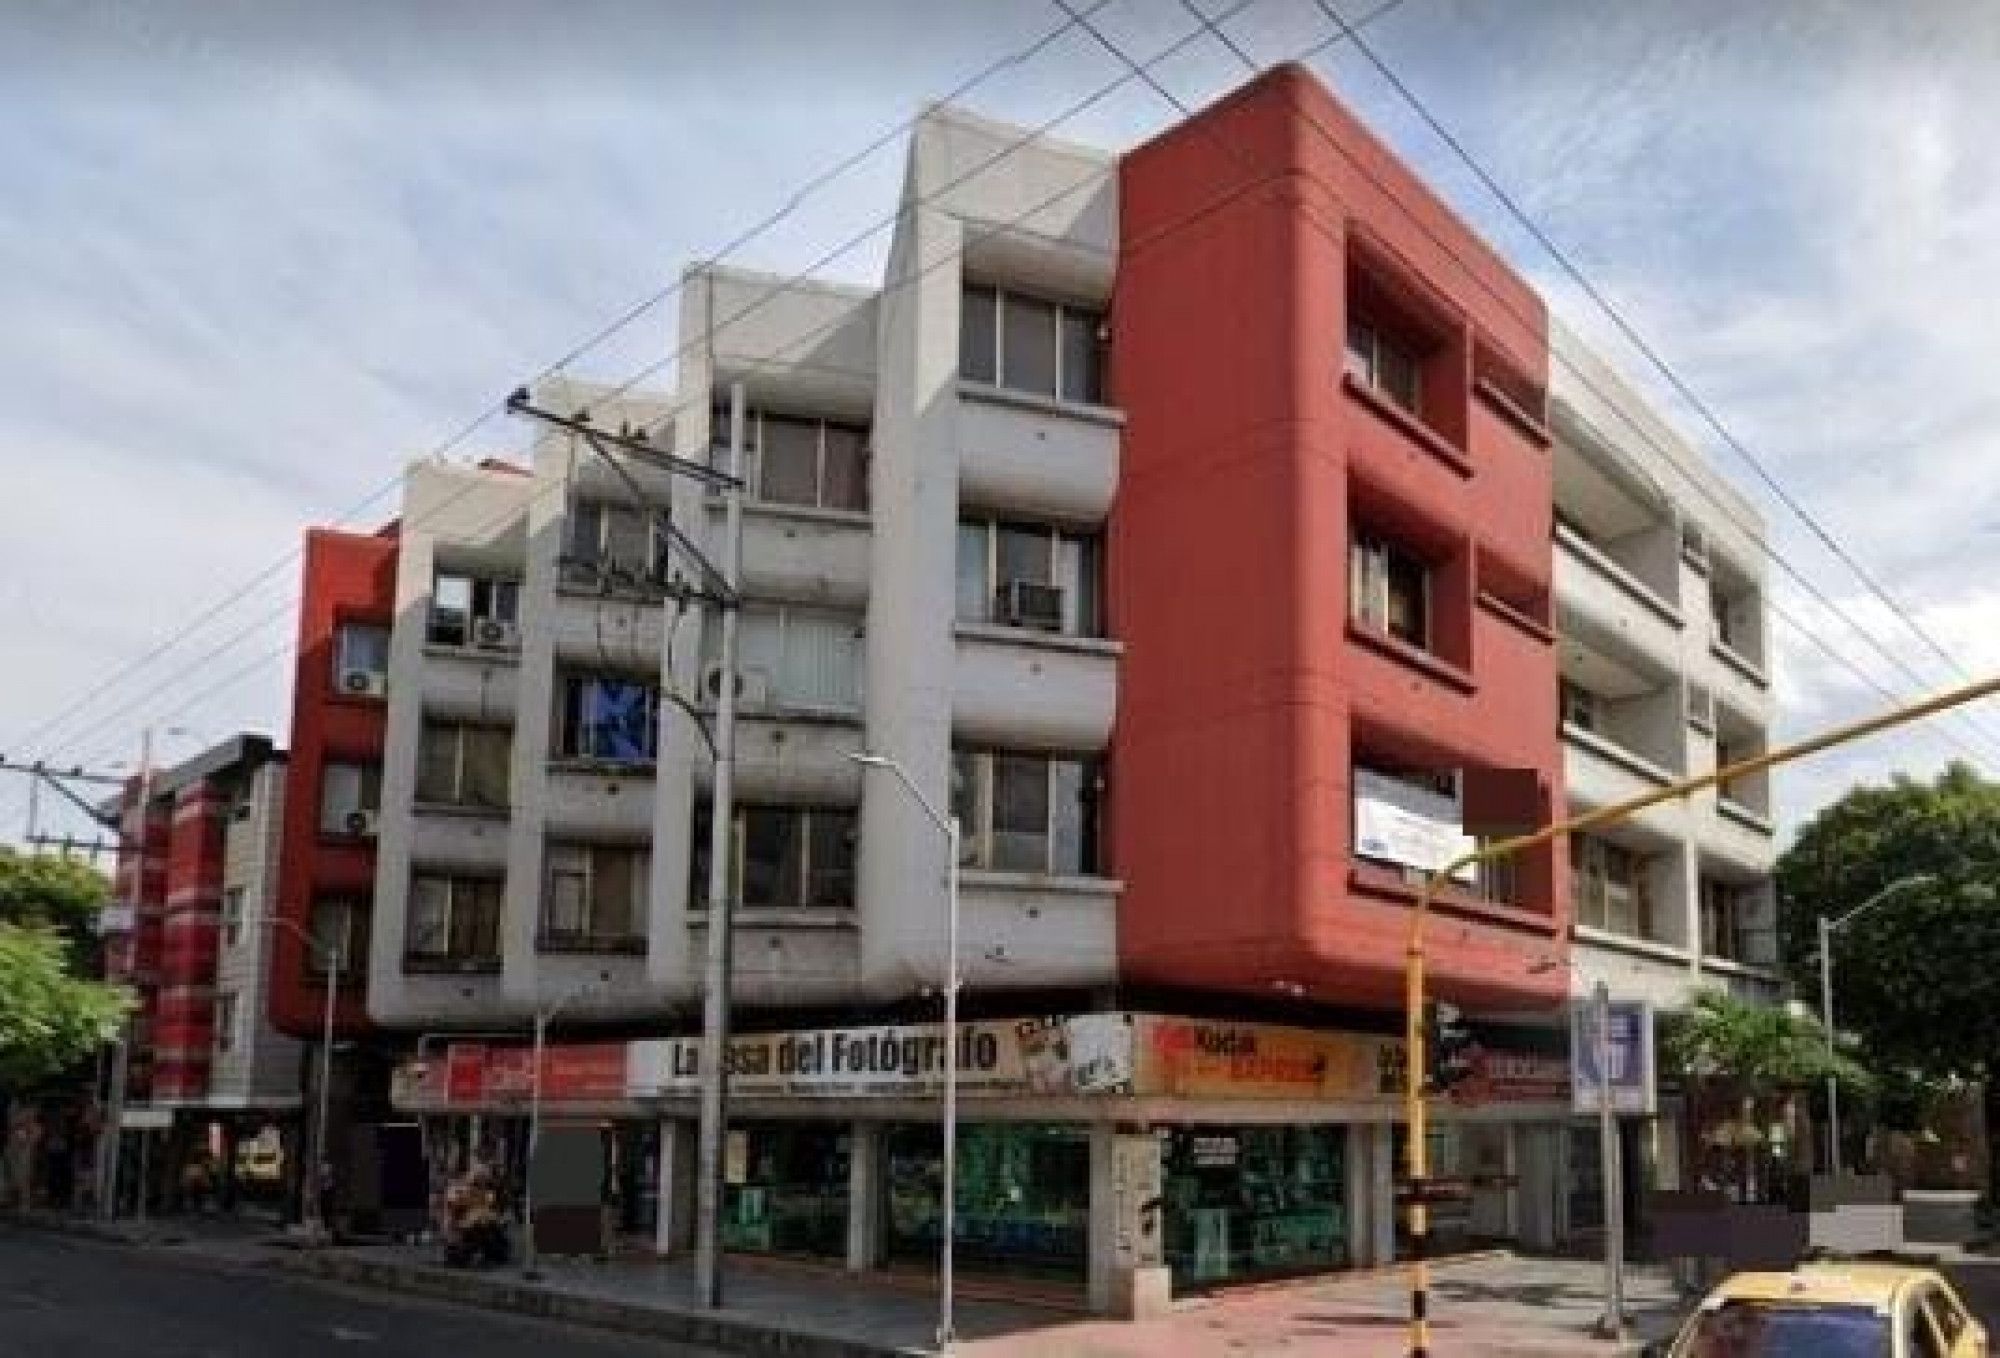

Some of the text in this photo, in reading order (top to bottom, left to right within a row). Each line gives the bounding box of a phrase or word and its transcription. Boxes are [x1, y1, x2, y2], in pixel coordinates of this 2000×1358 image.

[674, 1044, 699, 1075] La
[718, 1043, 770, 1075] asa
[777, 1032, 826, 1075] del
